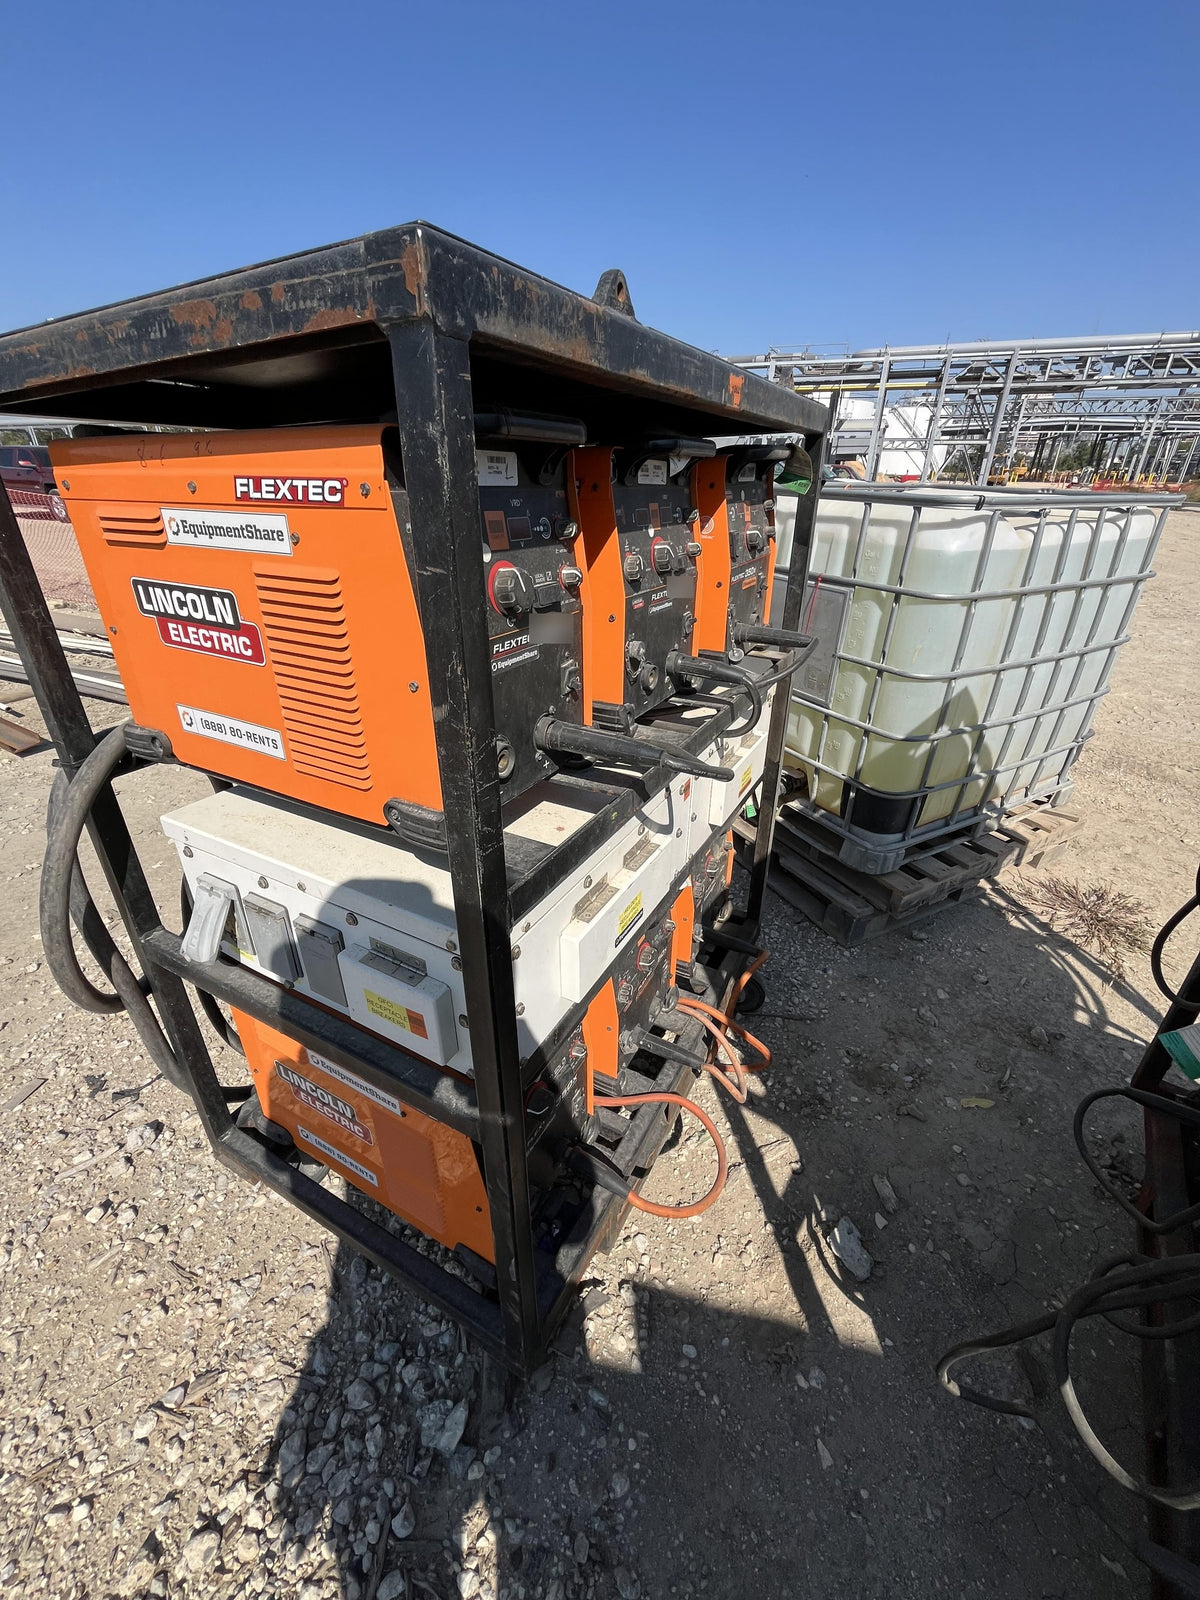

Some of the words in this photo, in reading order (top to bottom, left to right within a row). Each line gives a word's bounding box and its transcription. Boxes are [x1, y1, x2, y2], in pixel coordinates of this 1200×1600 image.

[235, 478, 342, 502] FLEXTEC
[180, 519, 285, 542] EquipmentShare
[137, 584, 236, 626] LINCOLN
[167, 622, 253, 657] ELECTRIC
[497, 649, 538, 669] EquipmentShare
[200, 717, 227, 735] (888)
[229, 726, 279, 750] 80-RENTS
[279, 1065, 353, 1119] LINCOLN
[320, 1061, 398, 1110] EquipmentShare
[300, 1091, 364, 1138] ELECTRIC
